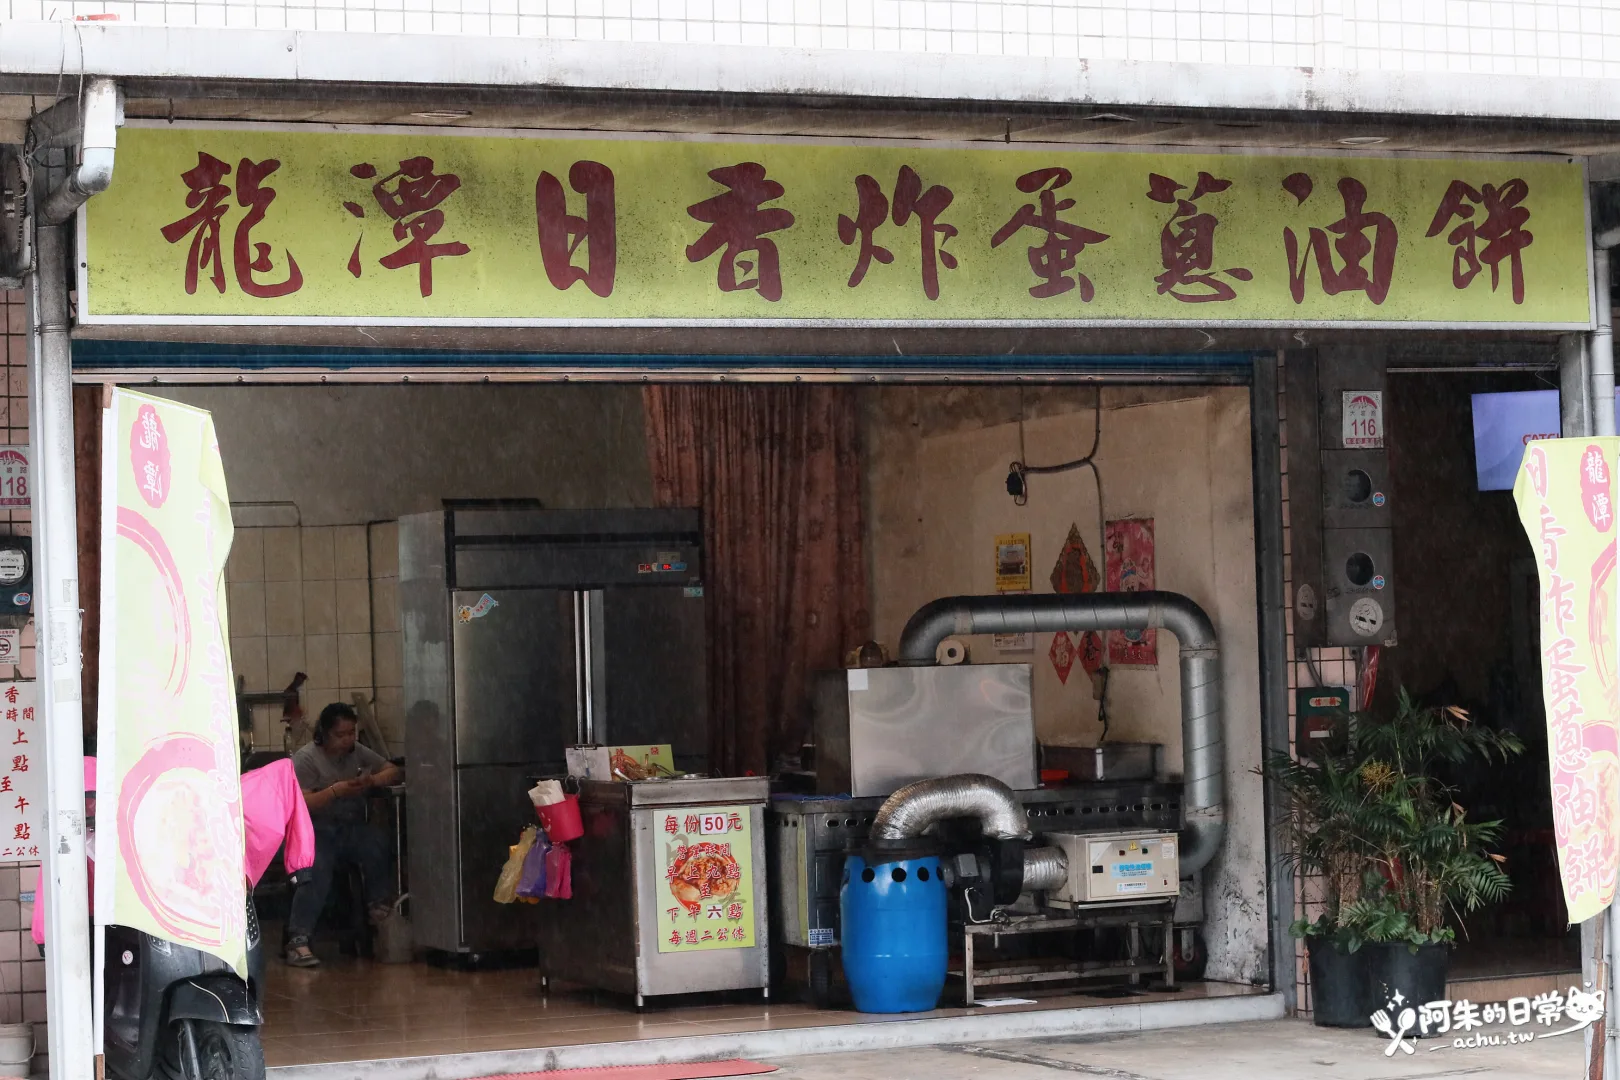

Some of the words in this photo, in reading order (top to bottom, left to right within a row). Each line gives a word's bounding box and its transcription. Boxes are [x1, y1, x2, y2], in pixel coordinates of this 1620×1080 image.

[1351, 418, 1376, 436] 116
[0, 475, 27, 497] 18
[1585, 450, 1611, 527] 龍潭
[5, 685, 20, 704] 香
[0, 706, 35, 722] 時間
[12, 728, 29, 745] 上
[11, 754, 29, 773] 點
[0, 775, 14, 793] 至
[14, 795, 30, 815] 午
[13, 822, 31, 840] 點
[664, 813, 742, 834] 每份50元
[2, 845, 40, 857] 二公休
[664, 864, 741, 884] 早上九點
[700, 883, 712, 899] 至
[667, 902, 744, 923] 下午六點
[668, 926, 745, 946] 每週二公休
